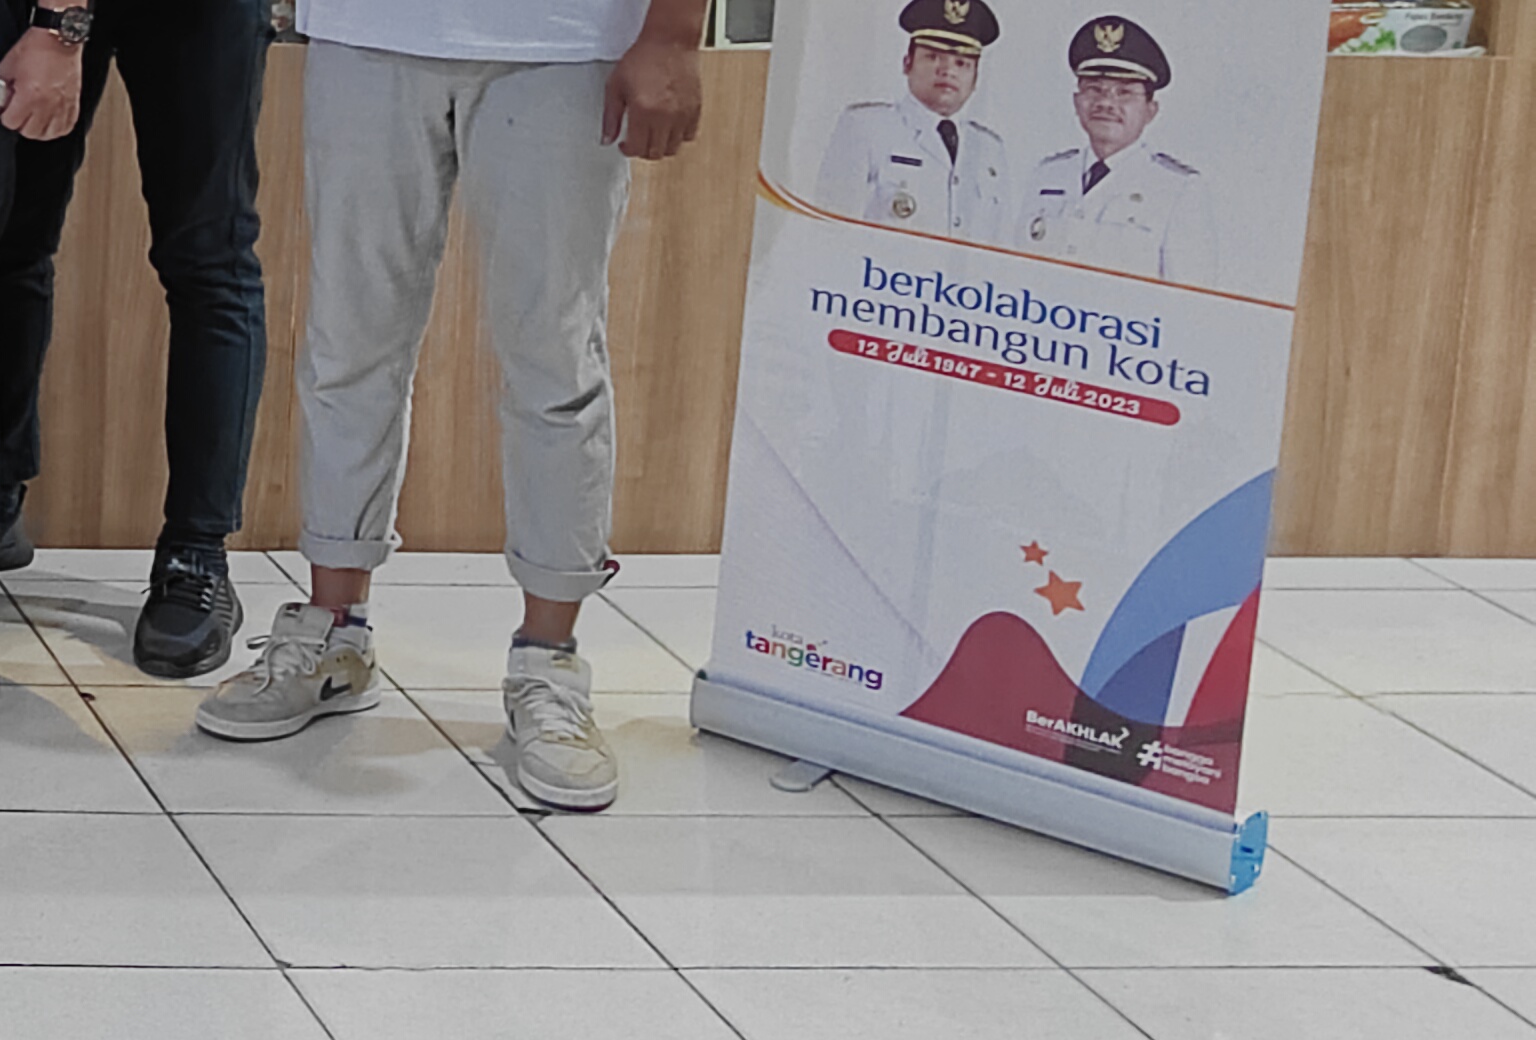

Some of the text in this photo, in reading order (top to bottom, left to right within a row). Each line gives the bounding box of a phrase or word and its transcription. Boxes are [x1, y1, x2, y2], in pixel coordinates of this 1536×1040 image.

[863, 257, 1162, 348] berkolaborasi
[811, 288, 1210, 396] membangun kota
[857, 338, 880, 357] 12
[885, 341, 929, 367] Juli
[933, 355, 982, 379] 1947
[1003, 371, 1026, 390] 12
[1033, 374, 1081, 402] Juli
[1083, 389, 1140, 415] 2023
[746, 630, 883, 690] tangerang
[772, 624, 803, 644] kota
[1026, 710, 1130, 749] BerAKHLAK
